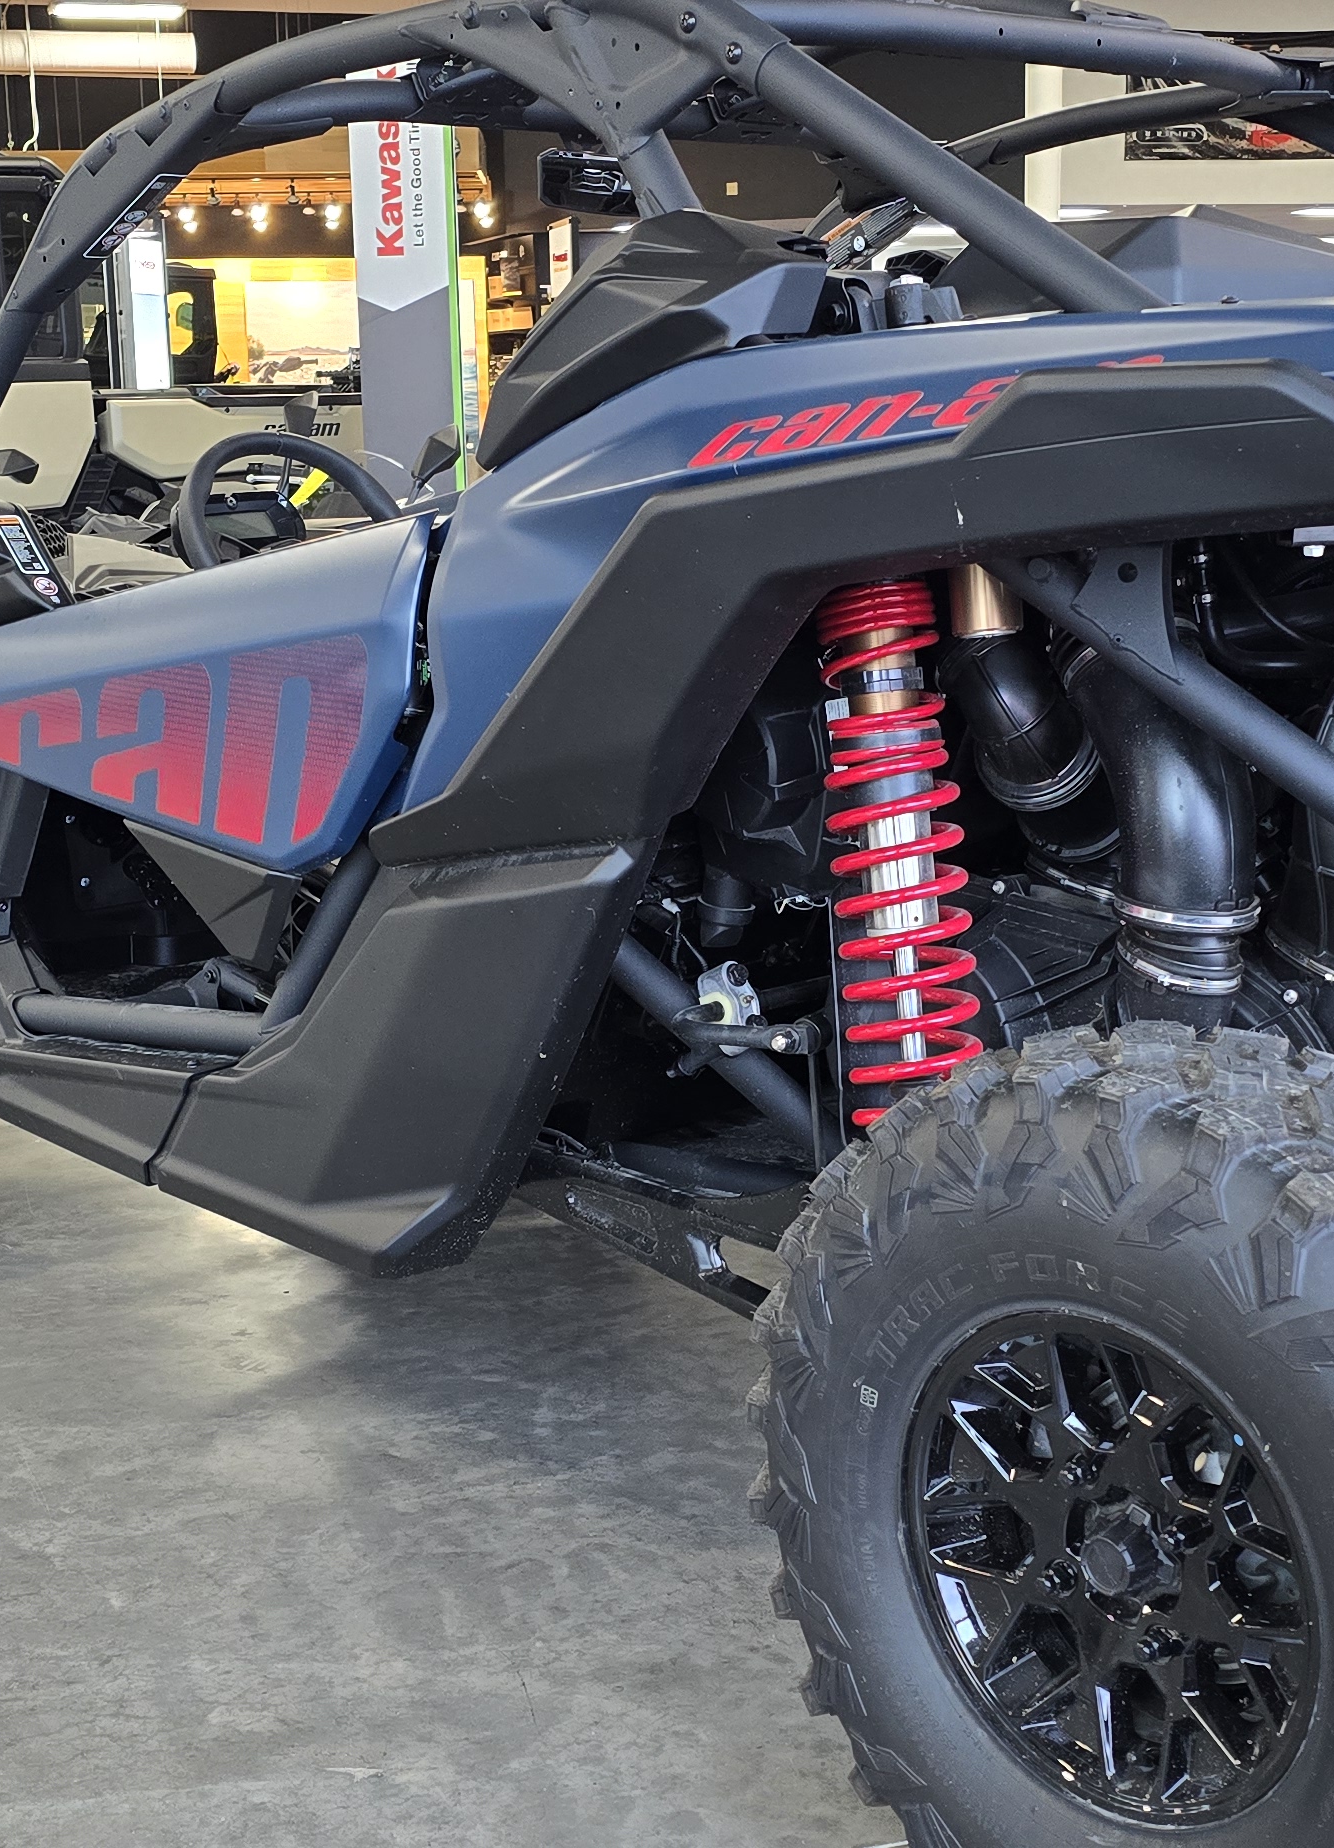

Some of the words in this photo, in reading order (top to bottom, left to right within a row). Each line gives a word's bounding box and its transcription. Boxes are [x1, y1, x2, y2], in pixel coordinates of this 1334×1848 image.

[411, 147, 423, 189] Good
[412, 193, 424, 218] the
[413, 223, 425, 247] Let
[866, 1263, 974, 1369] TRAC
[988, 1251, 1191, 1335] FORCE
